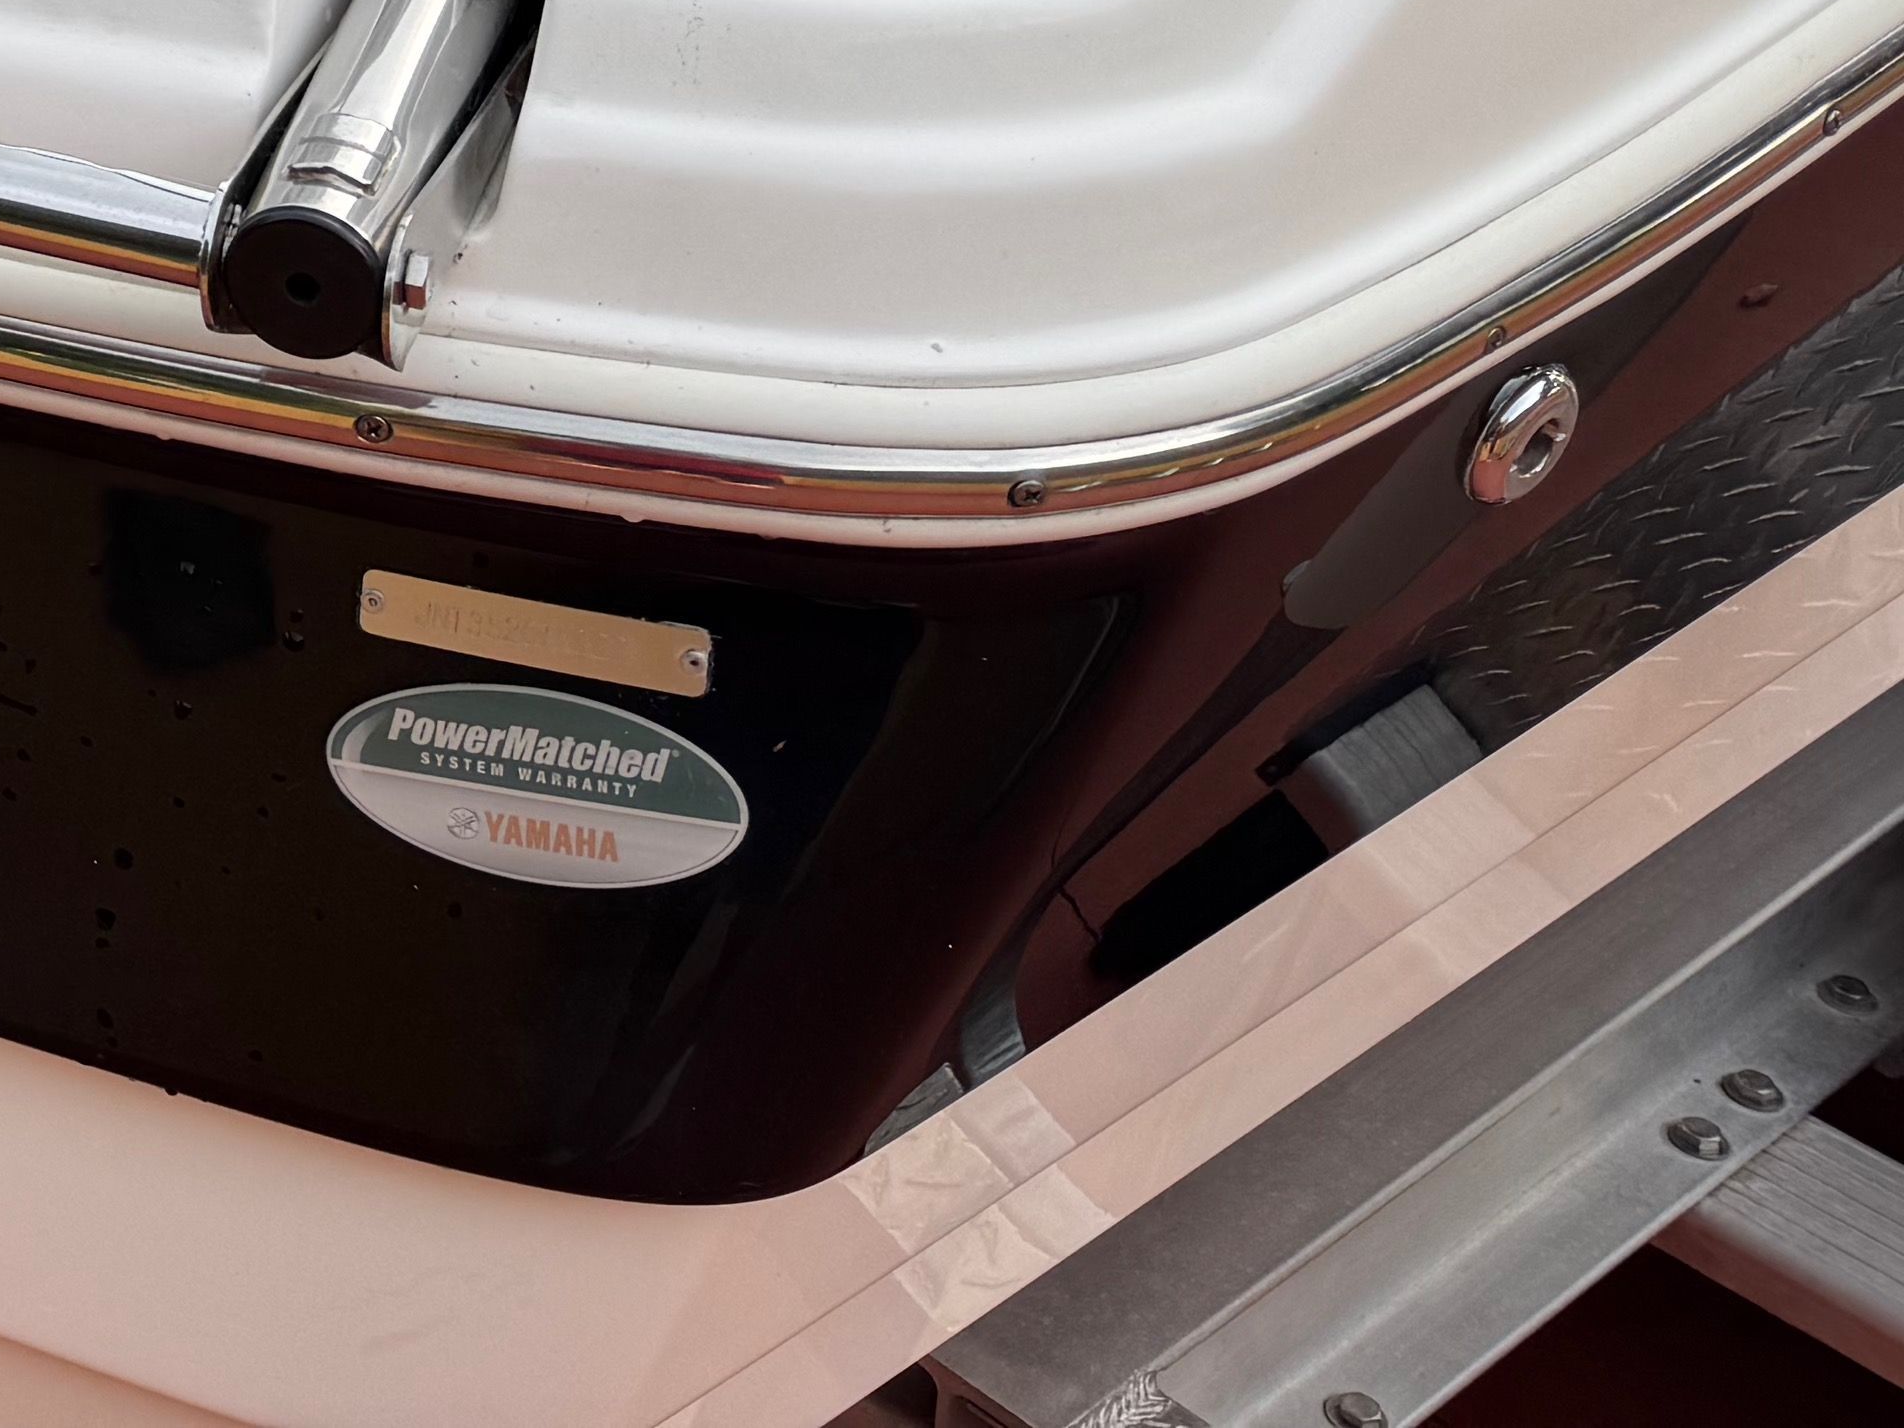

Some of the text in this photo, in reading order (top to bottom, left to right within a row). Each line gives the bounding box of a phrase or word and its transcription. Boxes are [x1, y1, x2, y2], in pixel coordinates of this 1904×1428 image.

[420, 751, 638, 798] SYSTEM WARRANTY
[484, 811, 620, 862] YAMAHA
